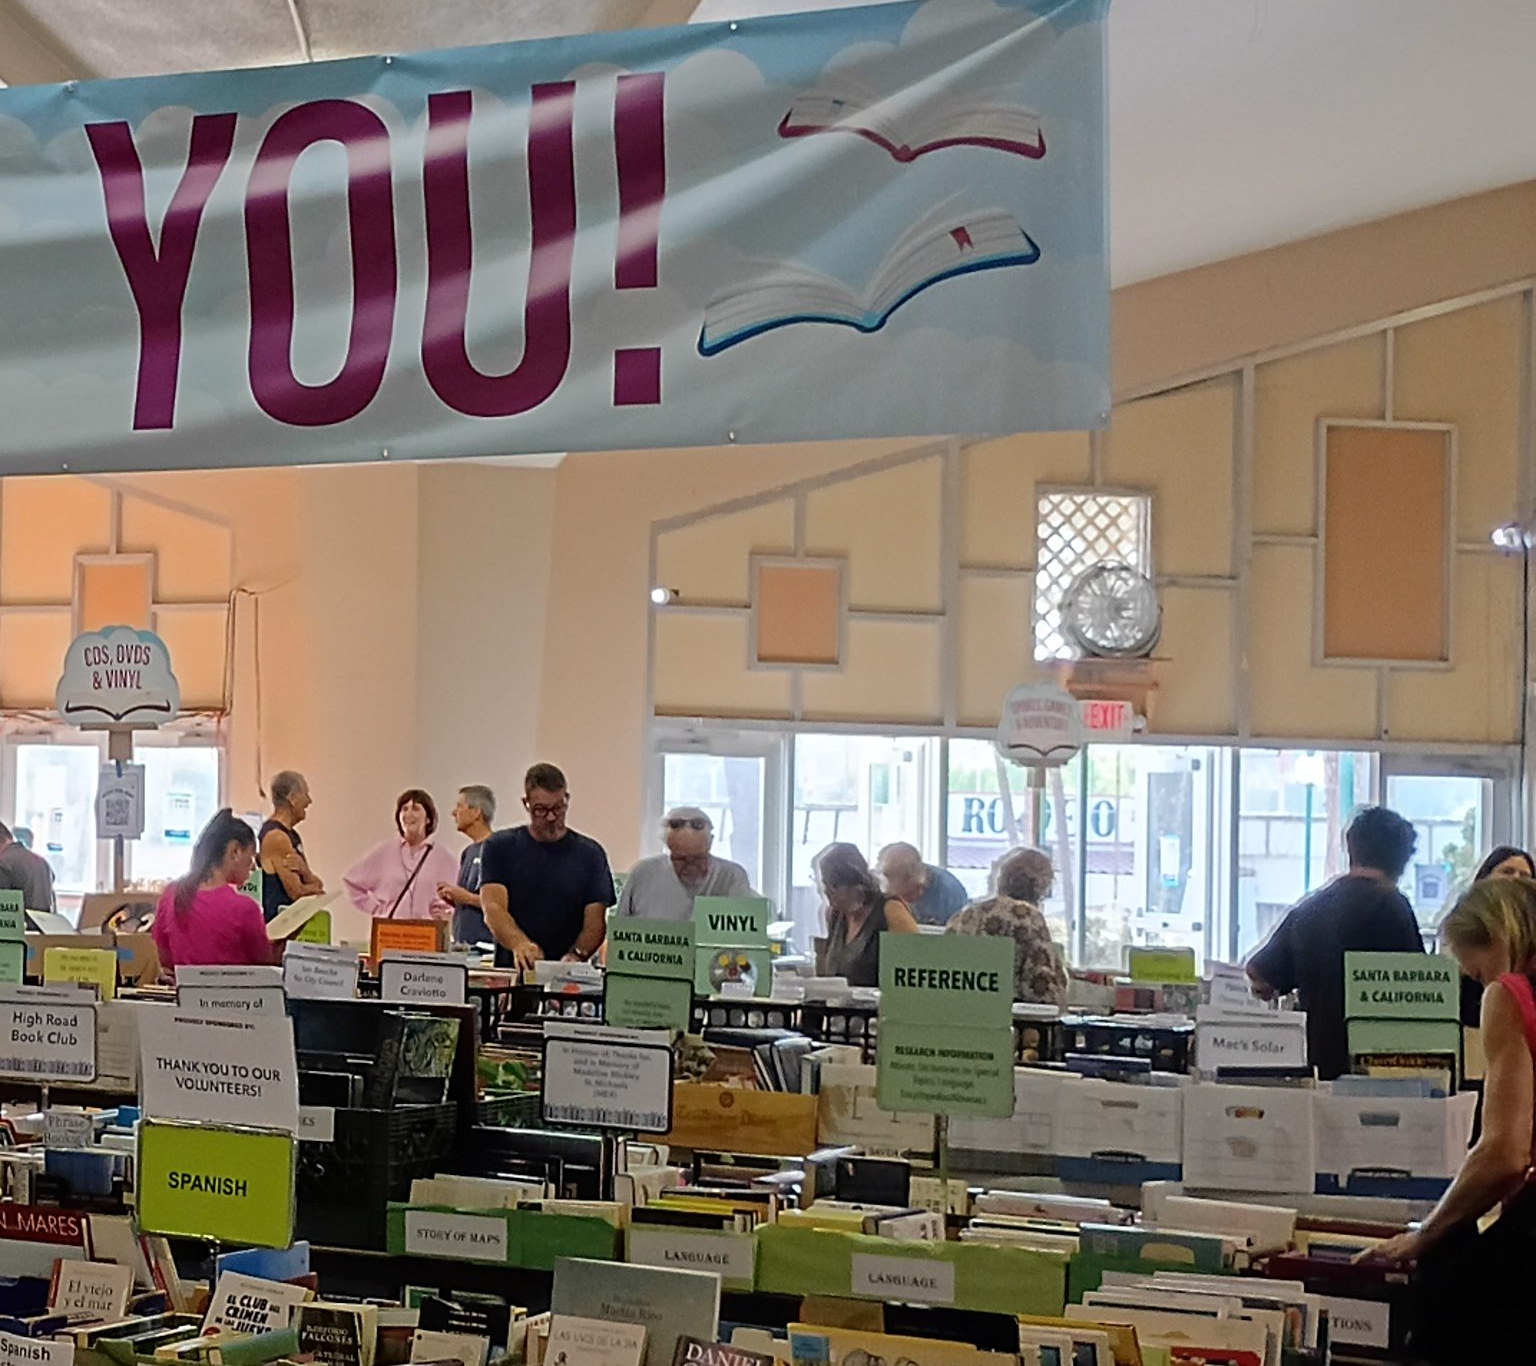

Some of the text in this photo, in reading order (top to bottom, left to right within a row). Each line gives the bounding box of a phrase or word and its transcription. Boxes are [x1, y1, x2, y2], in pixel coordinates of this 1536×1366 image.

[84, 73, 667, 430] YOU!
[117, 644, 151, 666] DVDS
[92, 669, 142, 690] & VINYL
[1091, 703, 1125, 729] EXIT
[708, 914, 758, 933] VINYL
[613, 930, 690, 948] SANTA BARBARA
[618, 950, 684, 966] & CALIFORNIA
[894, 967, 999, 992] REFERENCE
[1353, 968, 1451, 984] SANTA BARBARA
[199, 998, 209, 1008] In
[212, 999, 250, 1011] memory
[1360, 989, 1444, 1005] & CALIFORNIA
[12, 1012, 78, 1028] High Road
[11, 1030, 77, 1045] Book Club
[1251, 1038, 1286, 1054] Solar
[156, 1057, 281, 1082] THANK YOU TO OUR
[175, 1077, 262, 1097] VOLUNTEERS!
[49, 1115, 88, 1129] Phrase
[168, 1171, 248, 1197] SPANISH
[664, 1250, 730, 1265] LANGUAGE
[68, 1280, 113, 1298] El viejo
[868, 1273, 938, 1289] LANGUAGE
[74, 1296, 86, 1308] el
[88, 1300, 112, 1312] mar
[240, 1295, 268, 1310] CLUB
[225, 1306, 268, 1324] CRIMEN
[0, 1337, 51, 1362] Spanish
